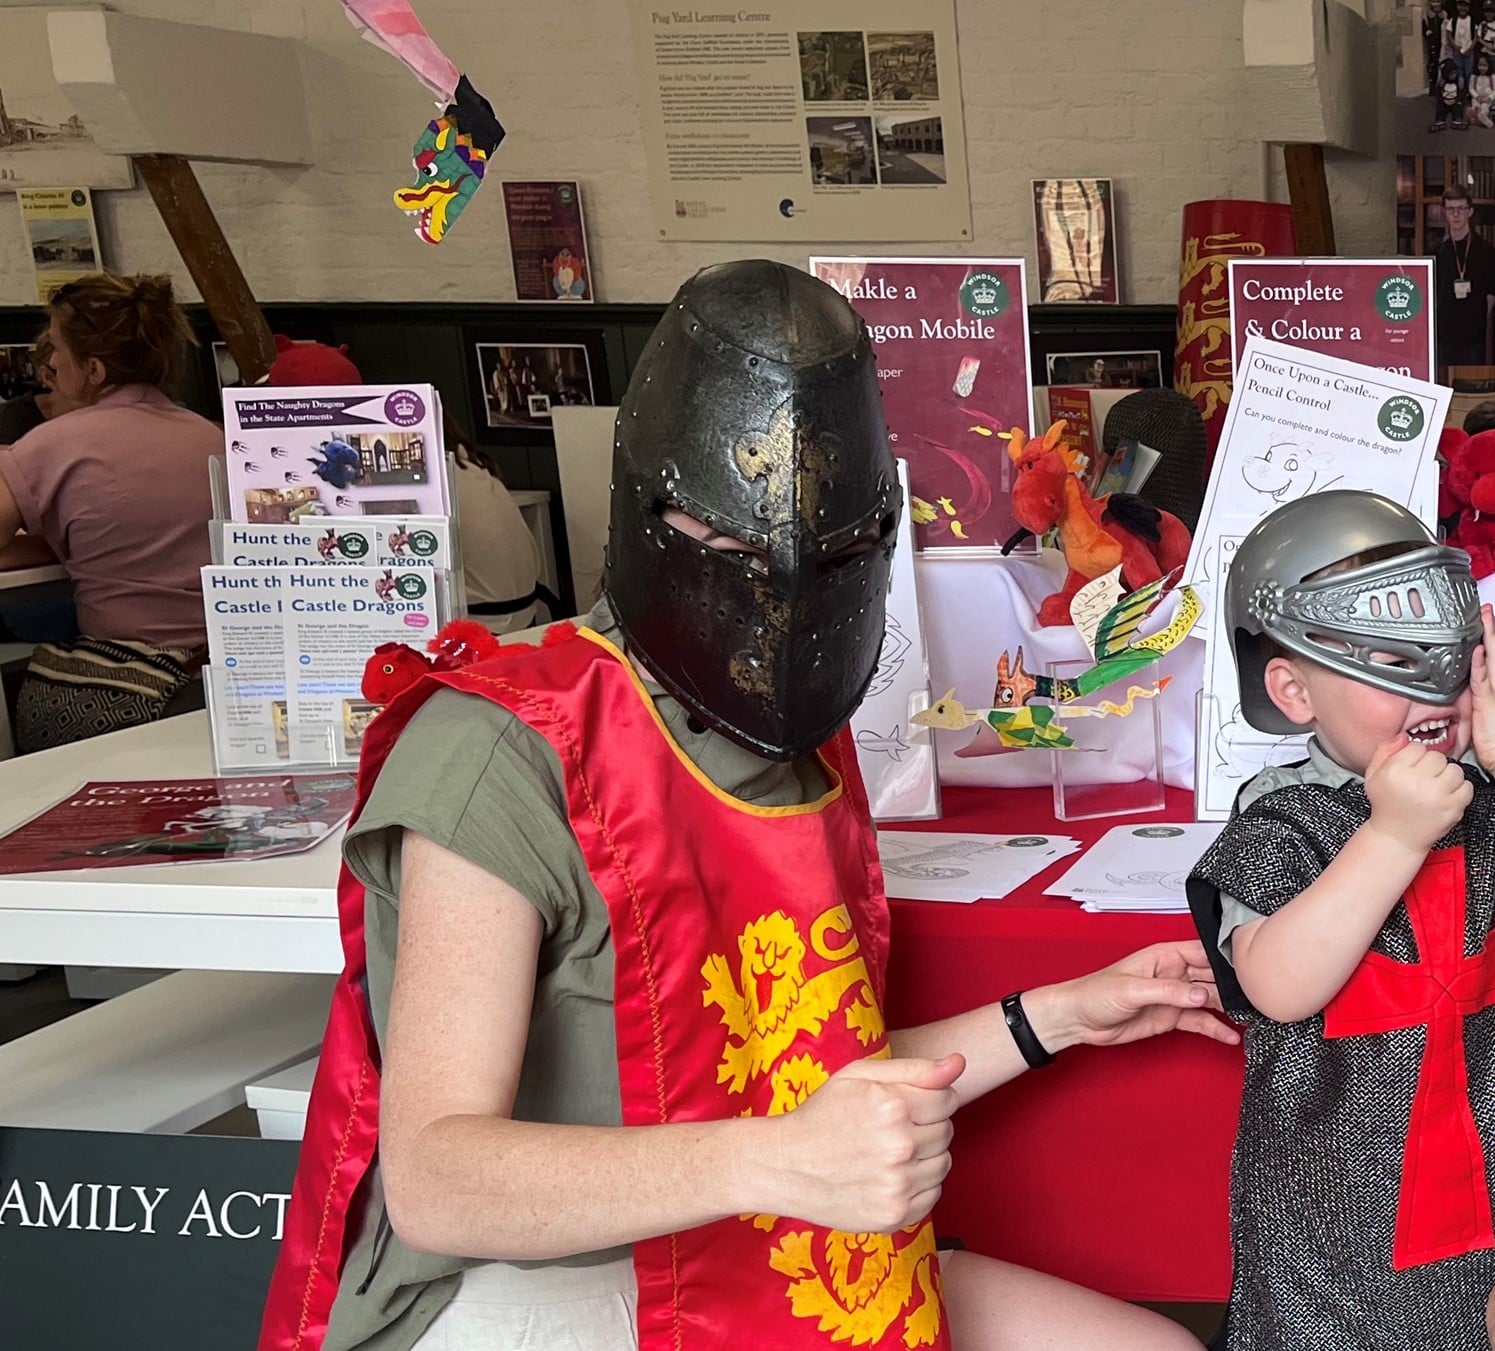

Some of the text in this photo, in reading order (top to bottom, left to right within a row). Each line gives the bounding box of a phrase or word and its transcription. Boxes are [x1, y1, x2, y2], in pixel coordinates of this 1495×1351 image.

[652, 10, 771, 25] Pug Yard Learning Centre
[967, 273, 1001, 286] WINDSOR
[1381, 276, 1415, 291] WINDSOR
[904, 285, 917, 300] a
[1242, 279, 1344, 306] Complete
[971, 305, 1000, 316] CASTLE
[1384, 310, 1412, 320] CASTLE
[920, 318, 995, 340] Mobile
[1244, 319, 1362, 340] & Colour a
[1253, 357, 1285, 376] Once
[1288, 365, 1321, 387] Upon
[1323, 378, 1331, 388] a
[1247, 378, 1332, 412] Pencil Control
[238, 400, 345, 412] Find The Naughty Dragons
[1388, 398, 1420, 416] WINDSOR
[240, 412, 333, 423] in the State Apartments
[1244, 406, 1402, 456] Can you complete and colour the dragon?
[1384, 425, 1411, 440] CASTLE
[233, 532, 311, 545] Hunt the
[233, 555, 288, 566] Castle
[379, 556, 435, 567] ragons
[212, 575, 258, 588] Hunt
[290, 574, 369, 587] Hunt the
[214, 599, 271, 613] Castle
[292, 598, 347, 612] Castle
[353, 599, 424, 615] Dragons
[88, 779, 291, 796] George and
[70, 791, 269, 807] the Dragon
[0, 1178, 292, 1241] AMILY ACT
